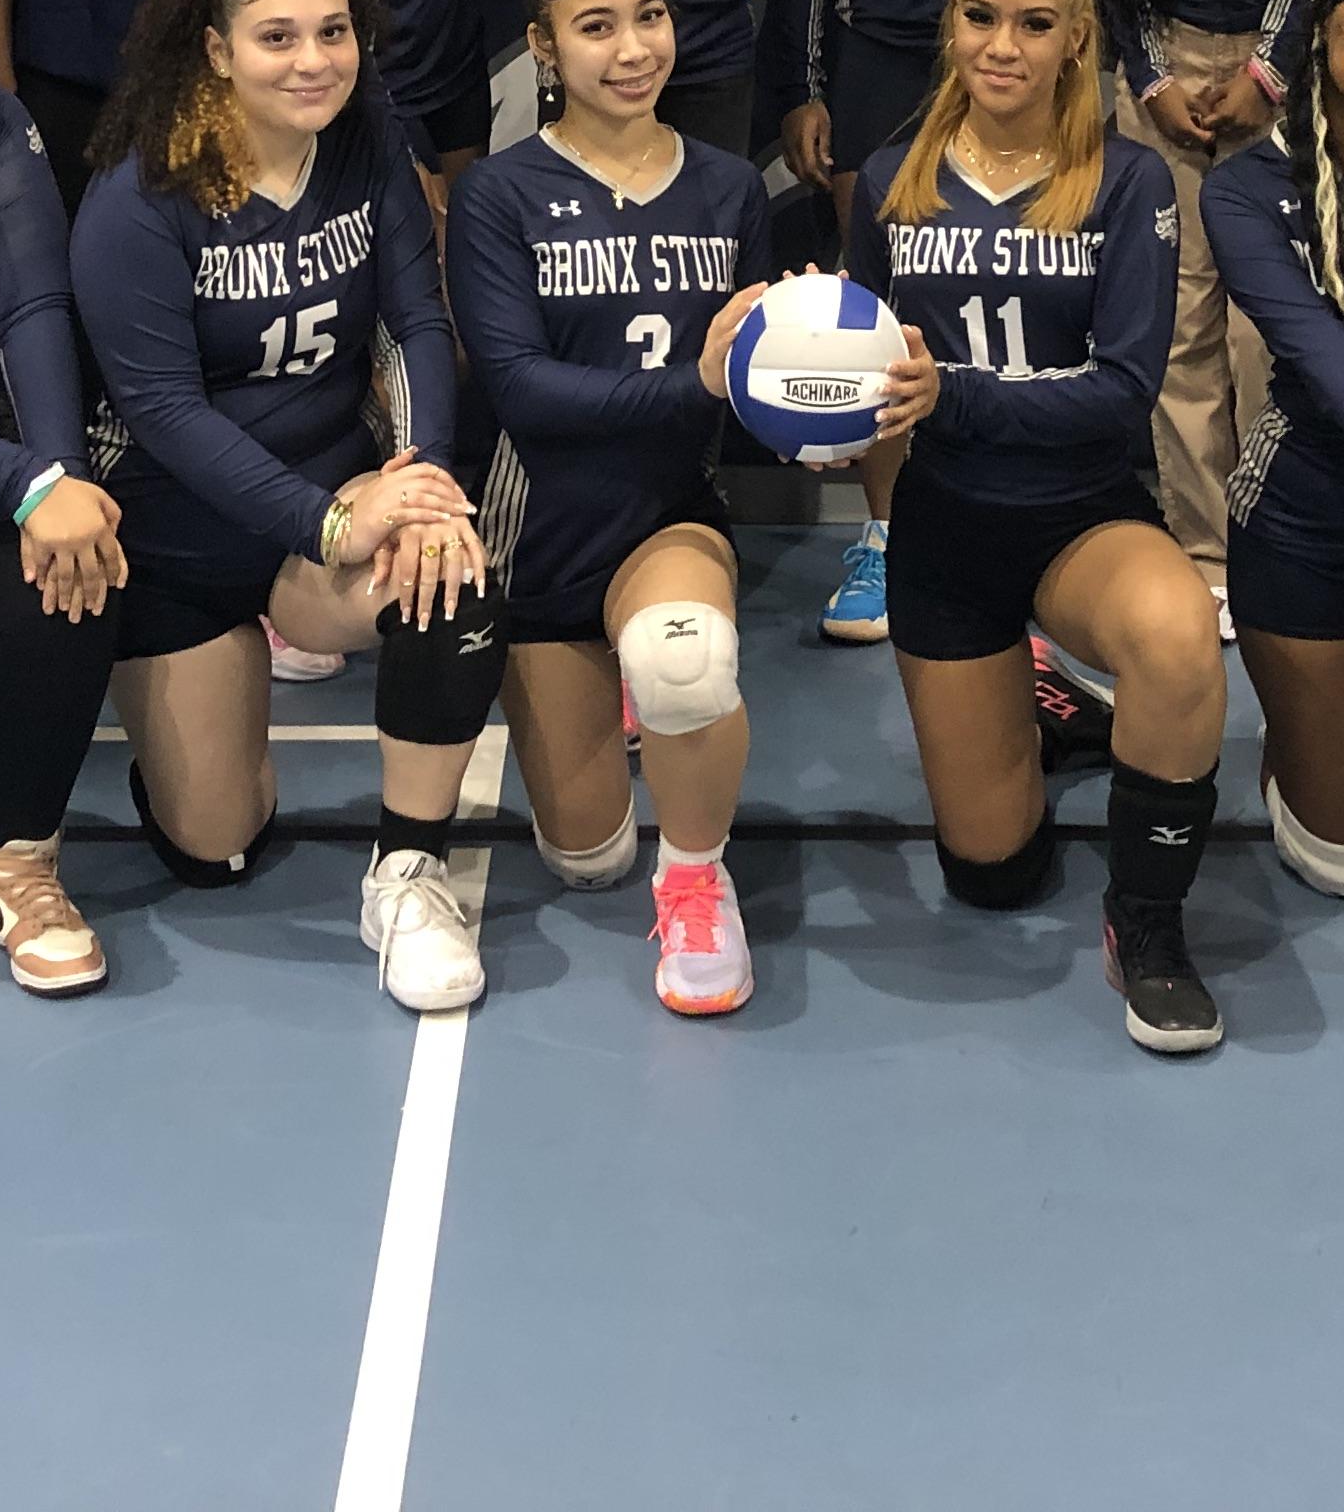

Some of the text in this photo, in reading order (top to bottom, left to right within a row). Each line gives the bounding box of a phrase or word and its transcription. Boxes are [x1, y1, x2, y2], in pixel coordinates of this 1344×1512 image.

[193, 242, 291, 300] BRONX
[531, 236, 641, 297] BRONX
[887, 223, 983, 277] BRONX
[246, 299, 339, 378] 15
[958, 295, 1034, 376] 11
[782, 377, 859, 402] TACHIKARA
